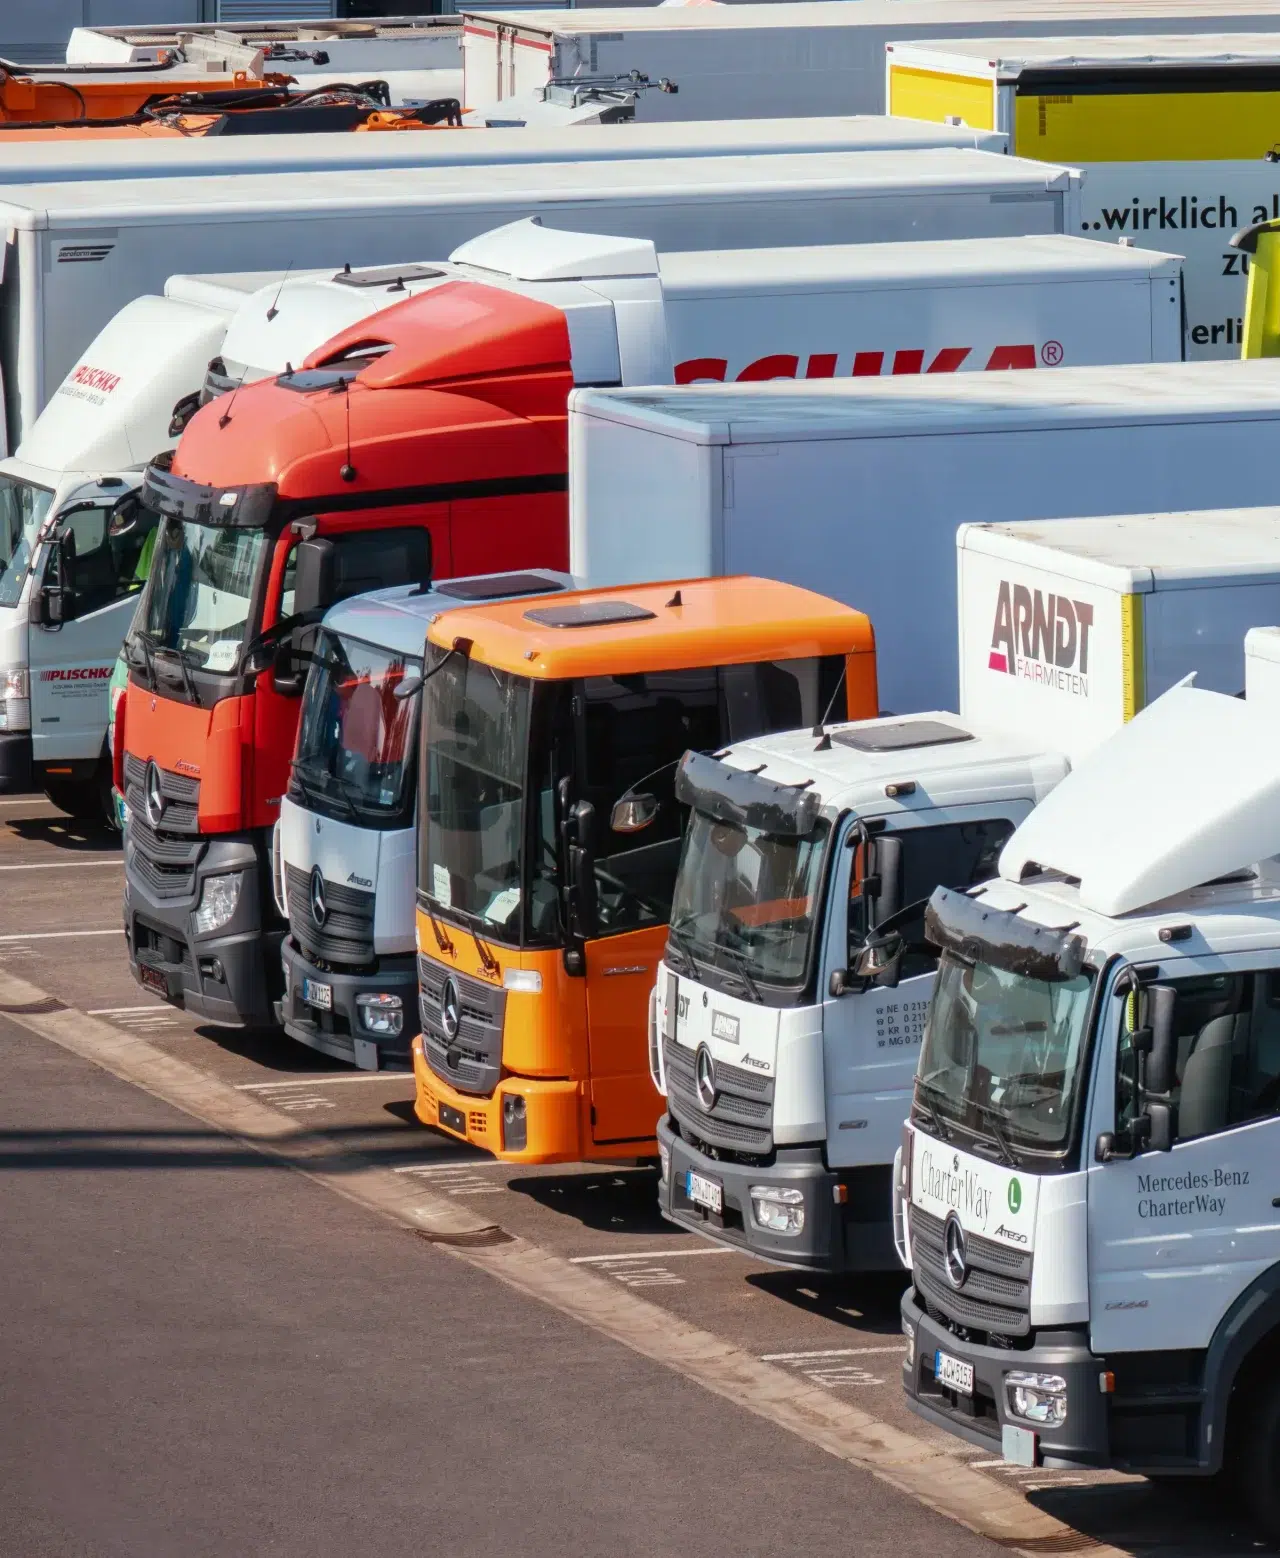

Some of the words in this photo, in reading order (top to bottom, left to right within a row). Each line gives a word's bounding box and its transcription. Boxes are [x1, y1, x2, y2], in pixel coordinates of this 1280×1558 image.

[991, 579, 1094, 676] ARNDT
[1017, 658, 1089, 698] FAIRMIETEN
[886, 1004, 898, 1013] NE
[887, 1015, 894, 1024] D
[888, 1026, 900, 1035] KR
[1137, 1168, 1250, 1193] Mercedes-Benz
[1138, 1194, 1226, 1218] CharterWay
[994, 1223, 1028, 1244] ATEGO
